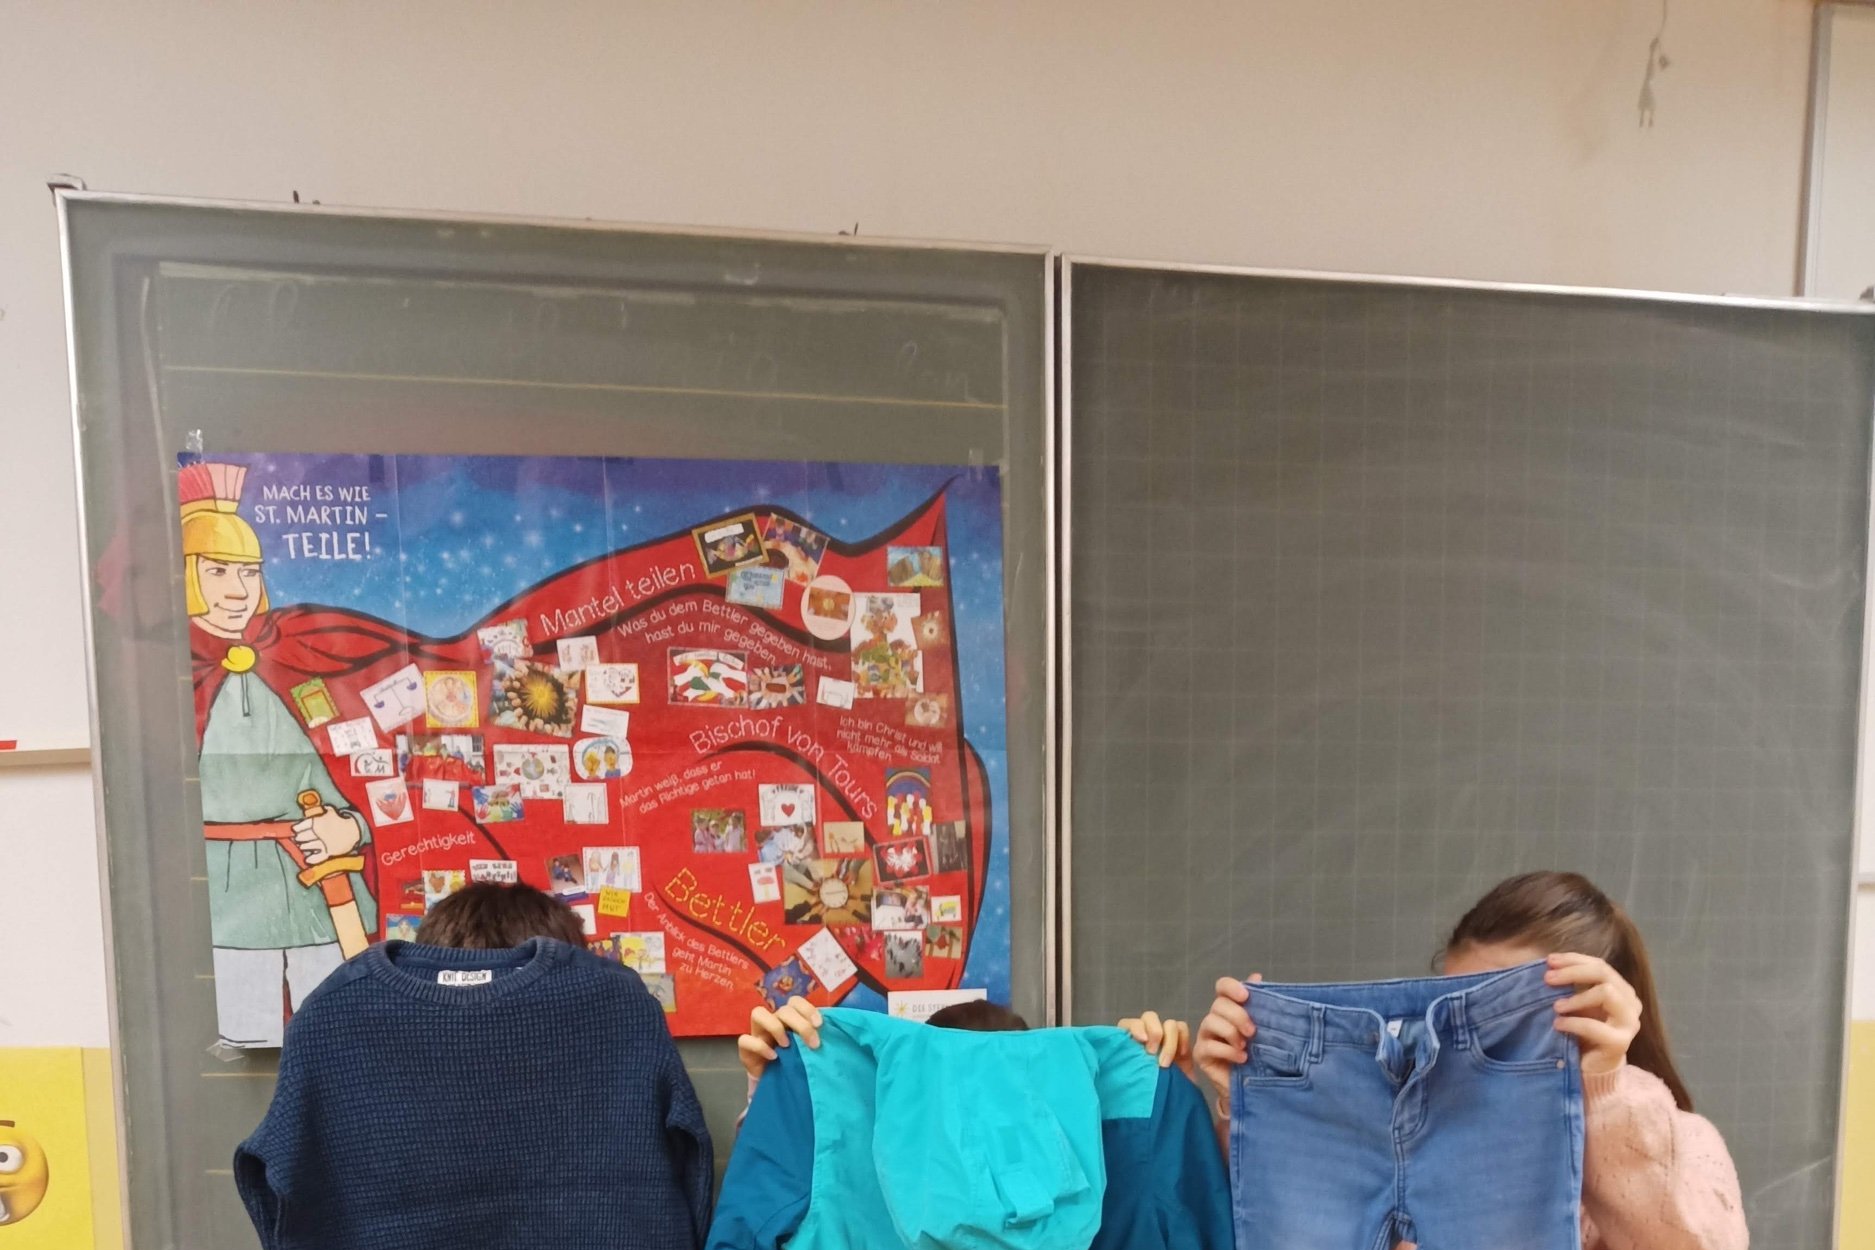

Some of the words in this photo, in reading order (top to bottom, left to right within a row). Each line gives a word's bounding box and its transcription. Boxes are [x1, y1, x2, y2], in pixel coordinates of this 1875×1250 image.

[263, 484, 310, 501] MACH
[316, 486, 334, 501] ES
[338, 486, 371, 502] WIE
[254, 504, 281, 524] ST.
[286, 504, 368, 525] MARTIN
[282, 531, 371, 560] TEILE!
[540, 586, 625, 636] Mantel
[625, 563, 696, 600] teilen
[617, 617, 648, 638] Was
[650, 608, 666, 624] du
[669, 600, 698, 616] dem
[702, 599, 749, 625] Bettler
[749, 620, 801, 658] gegeben
[645, 627, 675, 645] hast
[678, 620, 694, 634] du
[699, 620, 720, 634] mir
[840, 715, 855, 727] Ich
[857, 718, 873, 730] bin
[875, 722, 907, 743] Christ
[908, 738, 927, 751] und
[864, 734, 892, 749] mehr
[619, 785, 653, 808] Martin
[683, 763, 708, 780] dass
[710, 760, 722, 772] er
[689, 715, 783, 754] Bischof
[787, 726, 824, 762] von
[828, 754, 878, 819] Tours
[639, 800, 659, 814] das
[658, 781, 700, 804] Richtige
[701, 773, 732, 791] getan
[381, 831, 476, 866] Gerechtigkeit
[664, 867, 786, 951] Bettler
[643, 892, 660, 913] Der
[657, 913, 686, 943] Anblick
[686, 938, 705, 952] des
[707, 944, 750, 970] Bettlers
[671, 947, 696, 962] geht
[699, 954, 732, 975] Martin
[679, 962, 693, 974] zu
